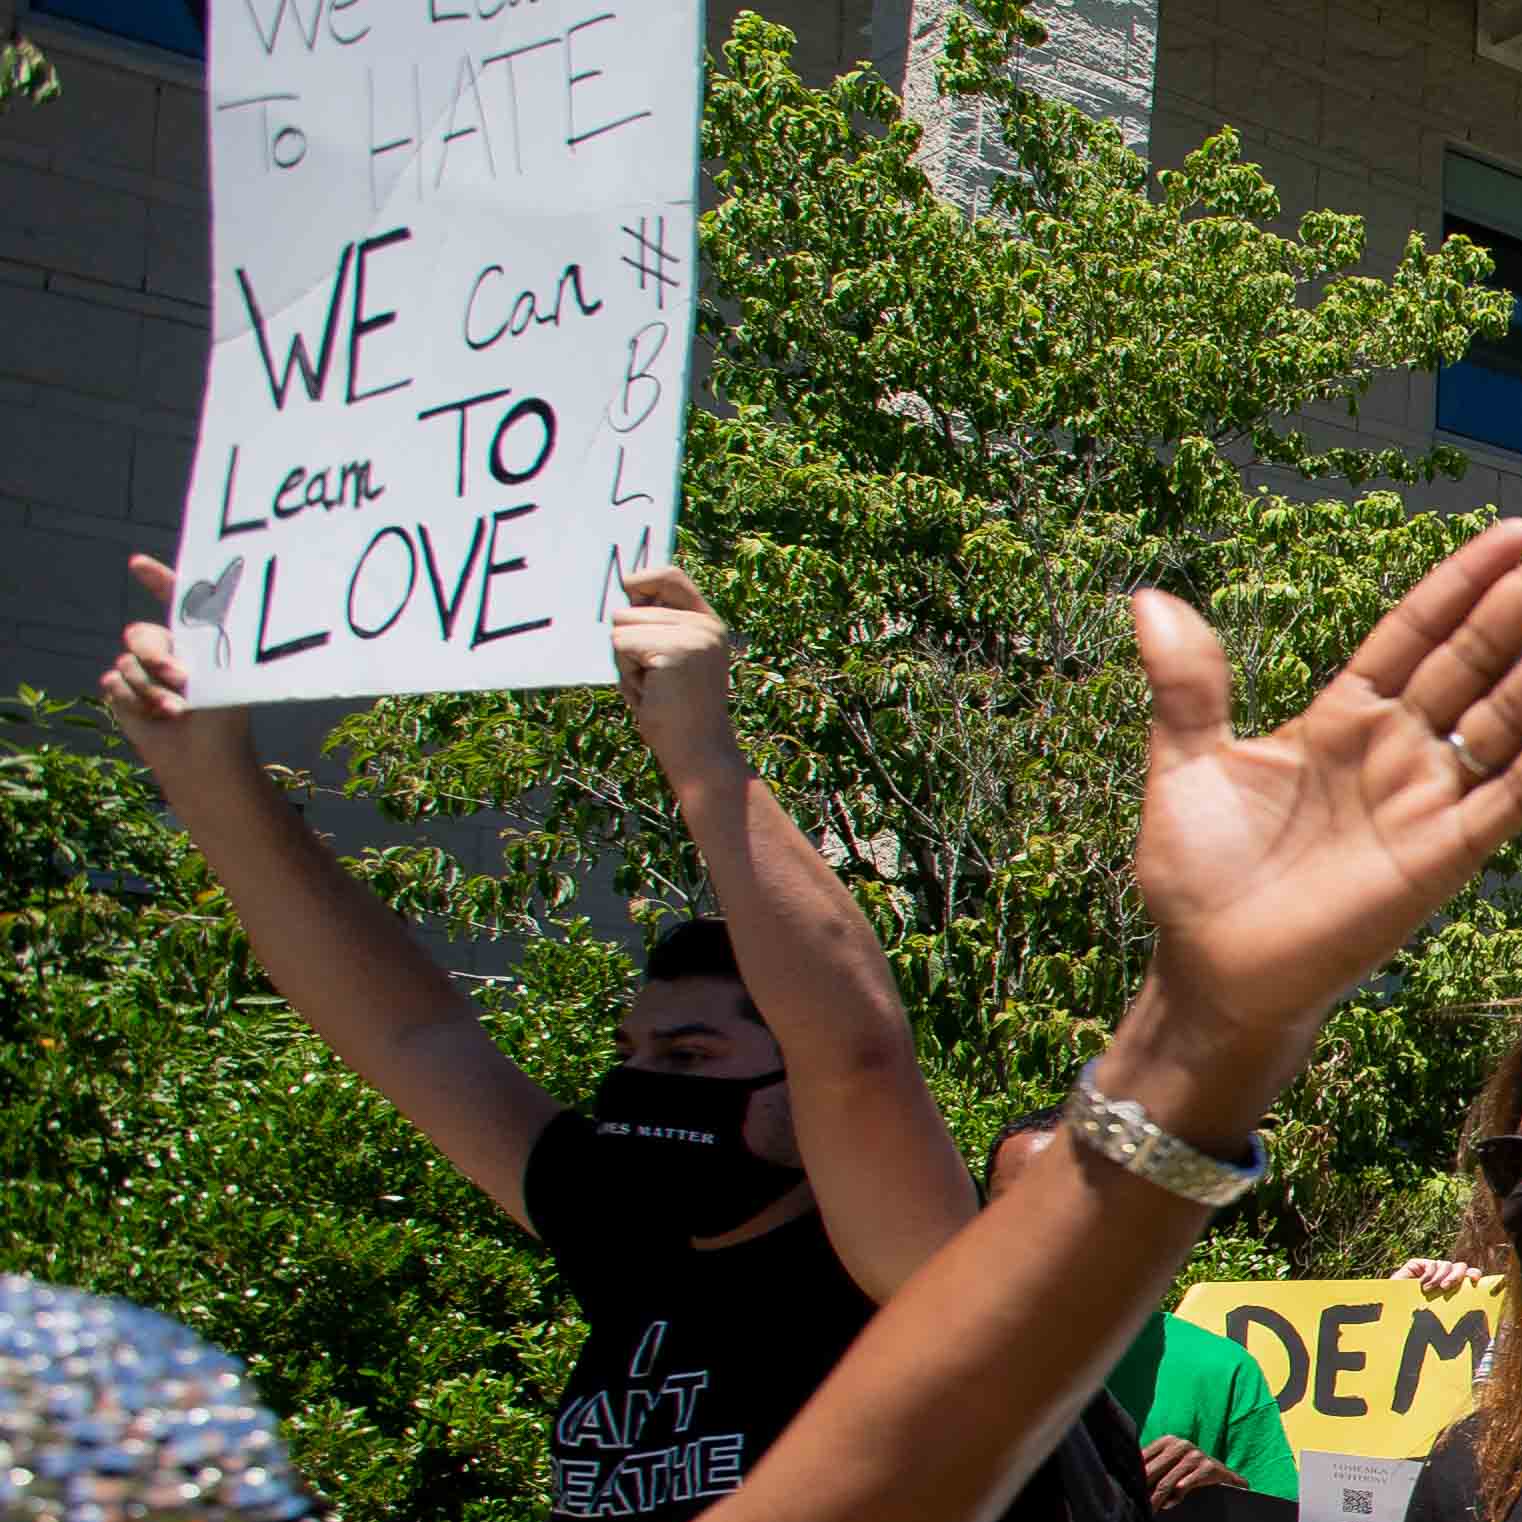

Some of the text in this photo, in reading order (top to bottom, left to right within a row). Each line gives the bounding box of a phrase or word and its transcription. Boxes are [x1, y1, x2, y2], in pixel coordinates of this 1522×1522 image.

[216, 14, 654, 212] To HATE
[236, 227, 603, 411] WE Can
[418, 389, 558, 498] TO
[255, 503, 553, 665] LOVE
[637, 1125, 715, 1144] MATTER
[552, 1432, 745, 1519] EATHE
